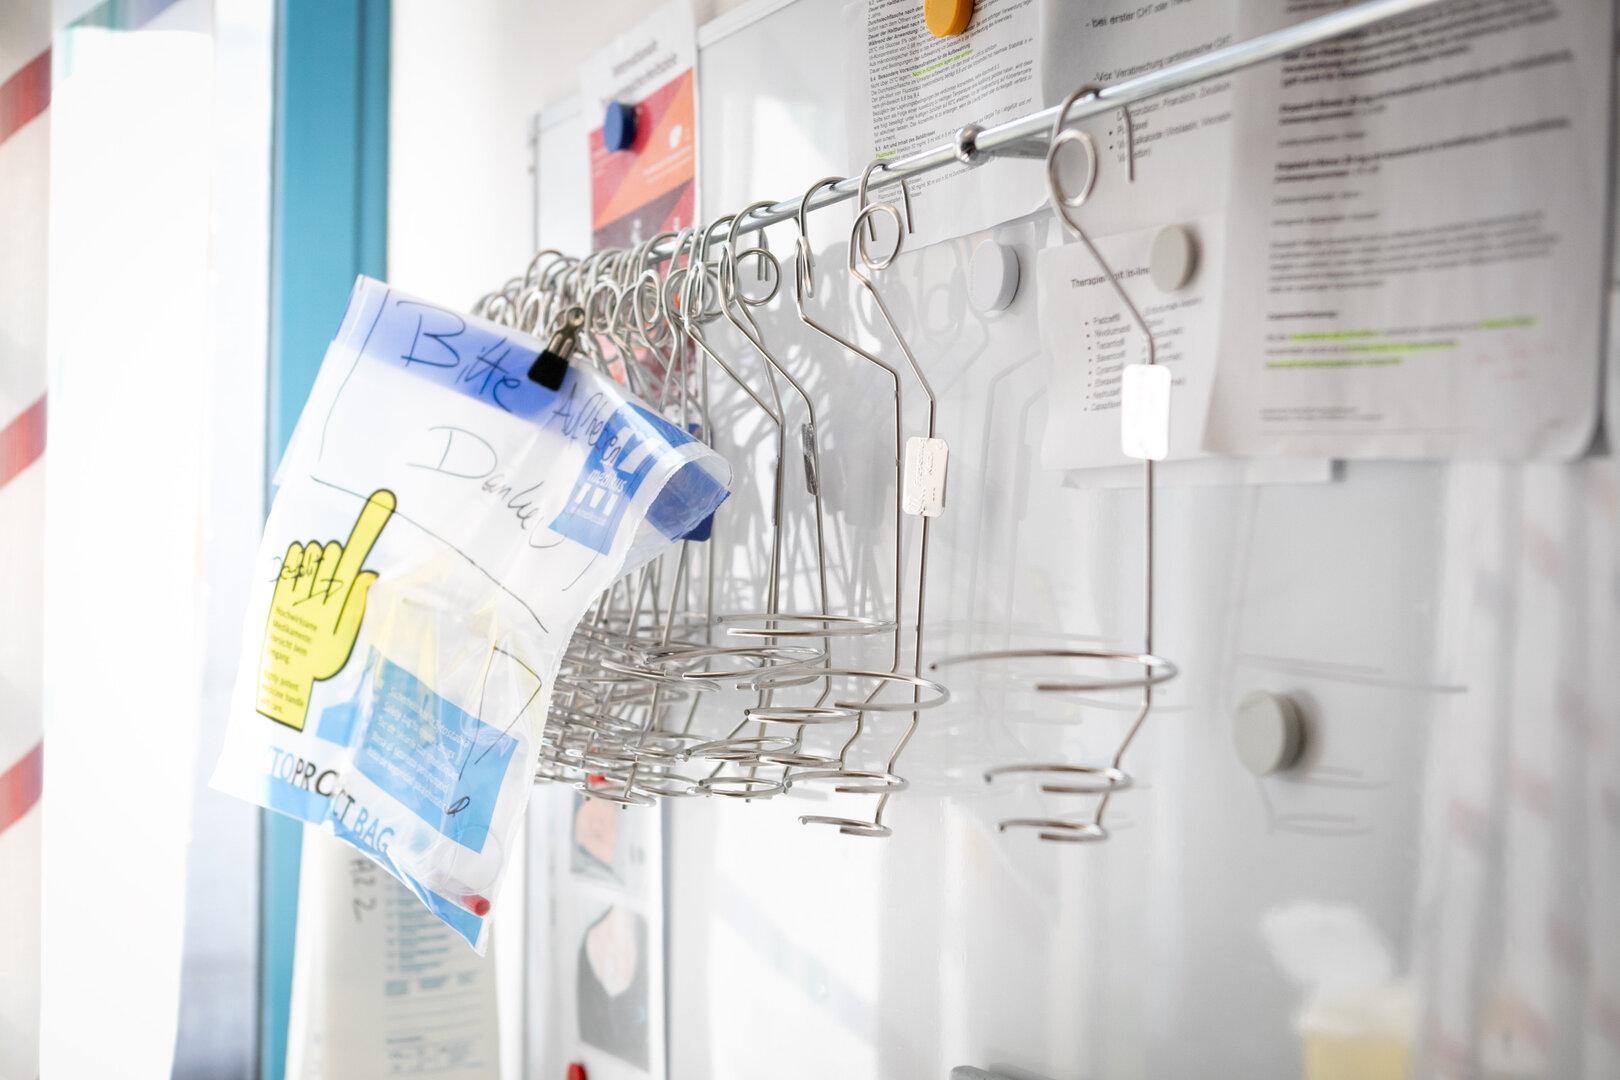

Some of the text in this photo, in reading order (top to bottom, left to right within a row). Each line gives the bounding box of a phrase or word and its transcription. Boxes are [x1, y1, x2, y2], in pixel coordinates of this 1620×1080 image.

[1092, 17, 1107, 28] bei
[1110, 12, 1134, 25] erster
[396, 300, 521, 414] Bitte
[354, 806, 395, 854] BAG
